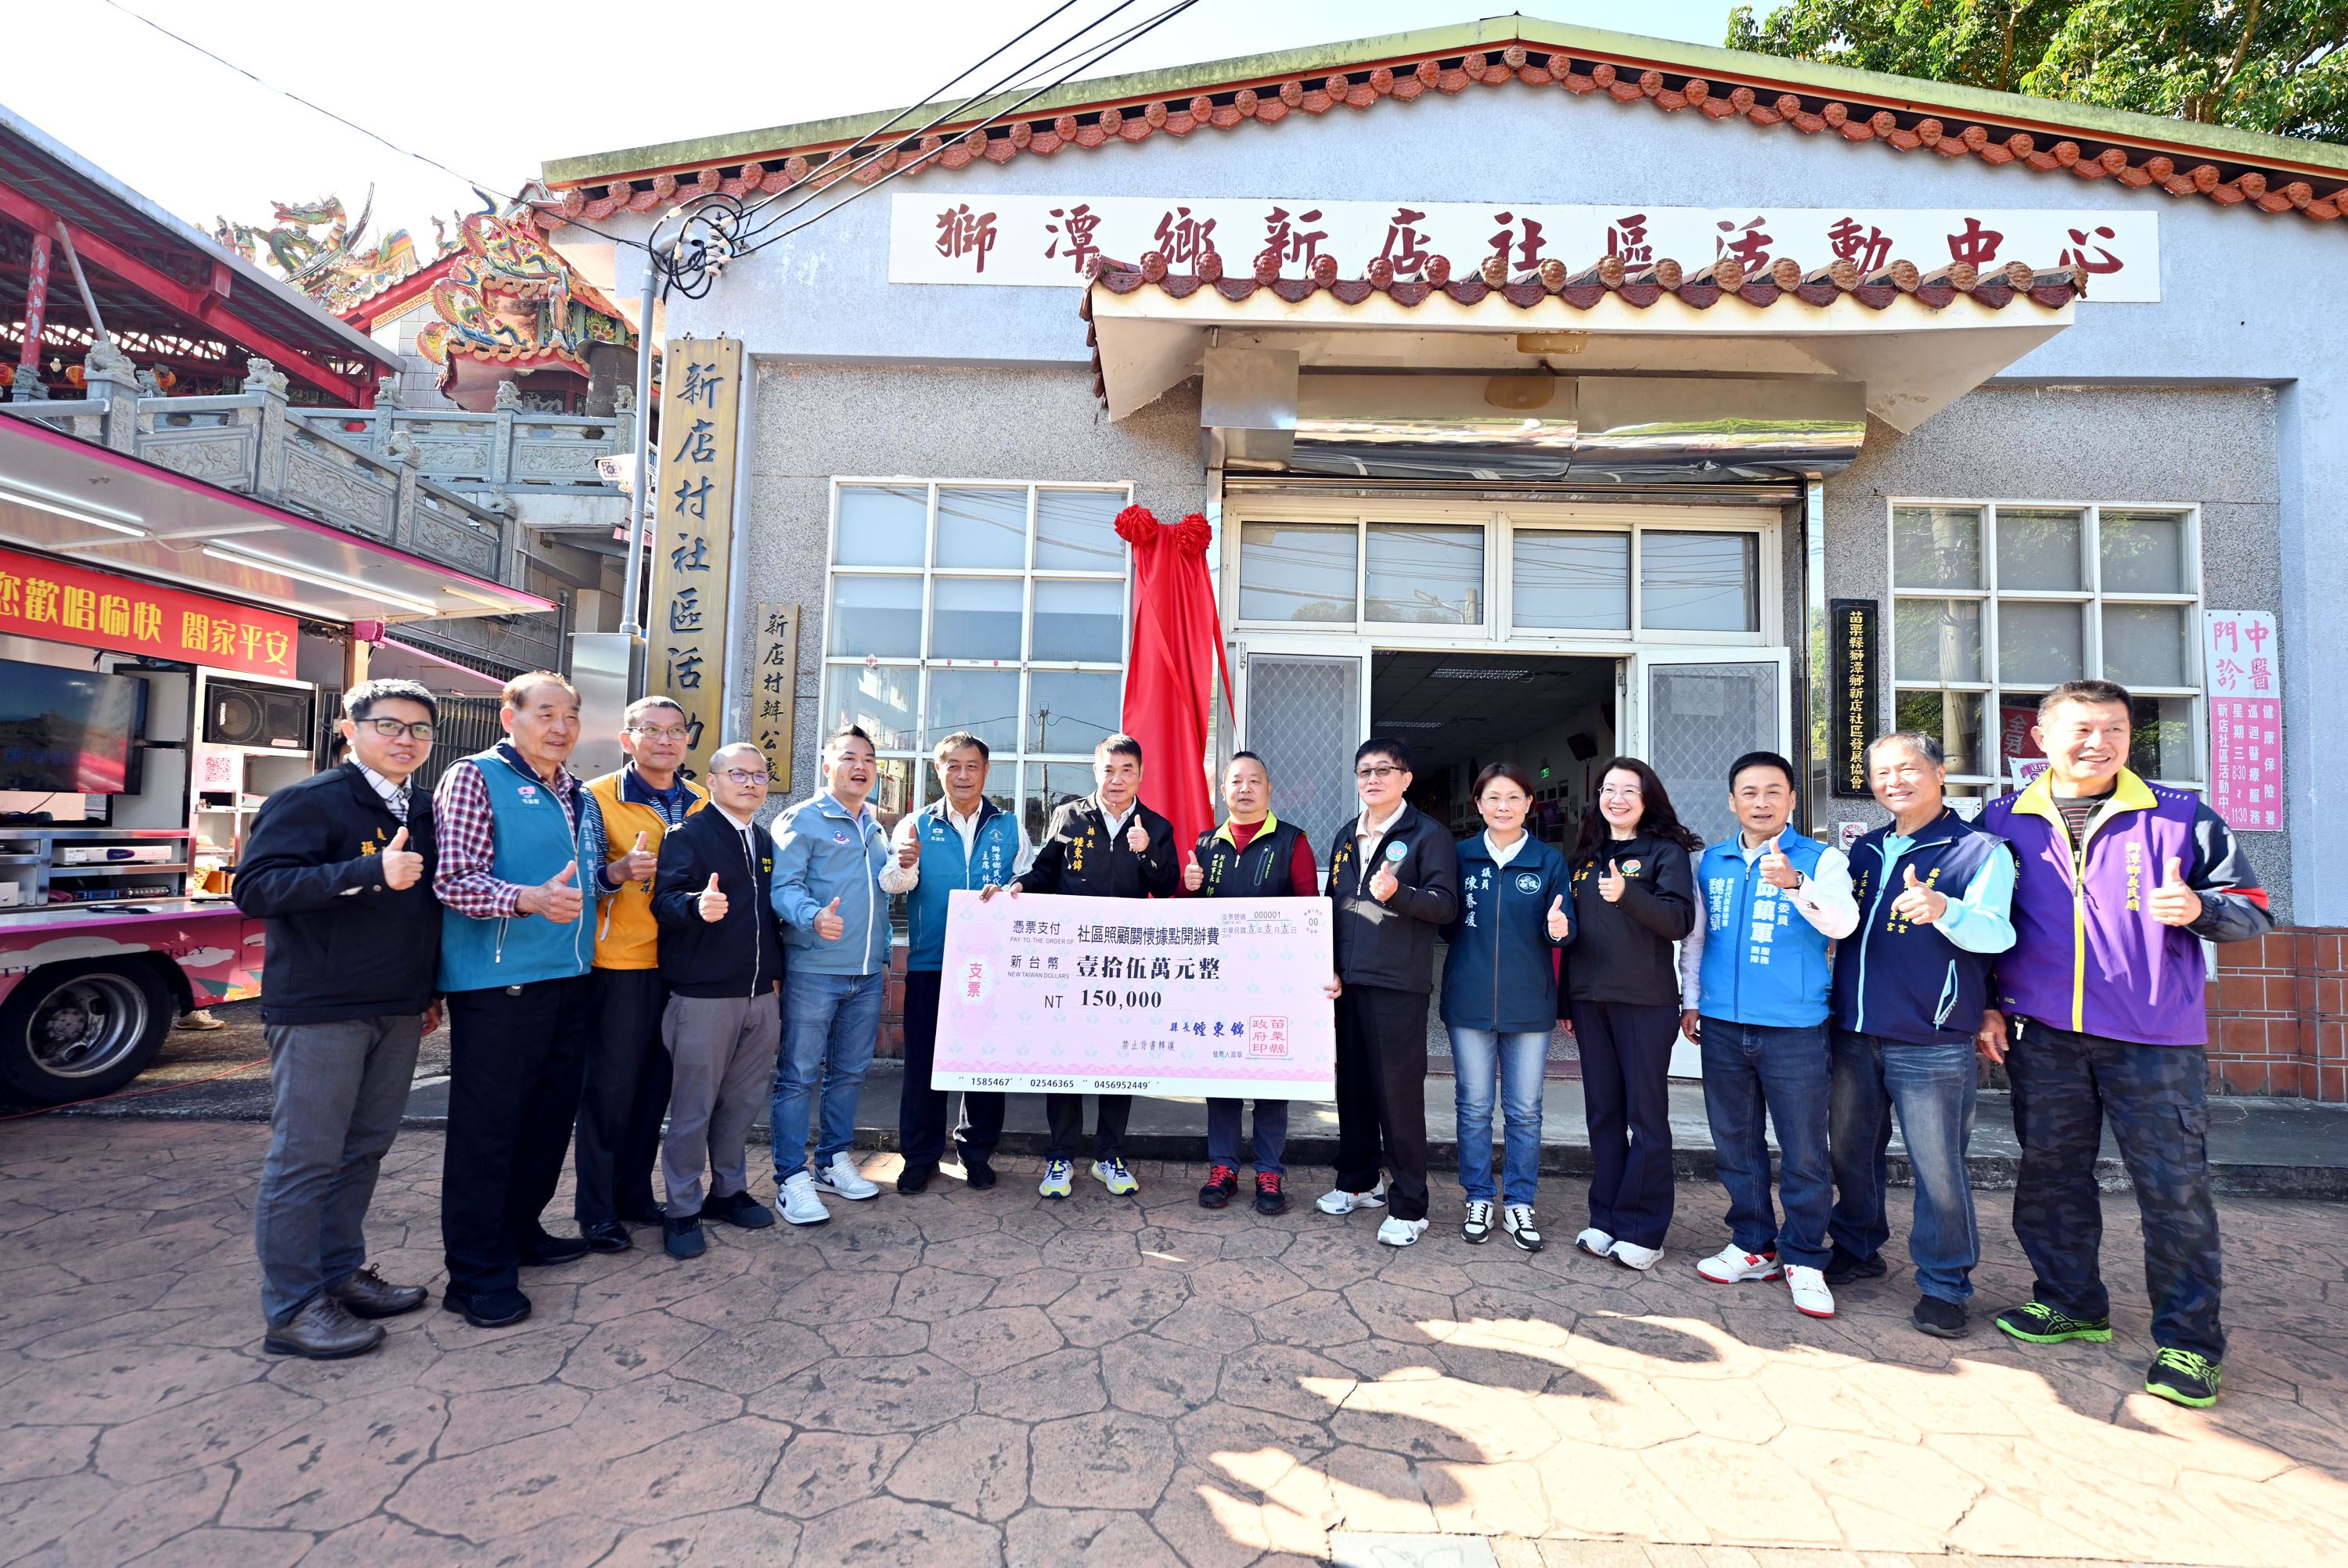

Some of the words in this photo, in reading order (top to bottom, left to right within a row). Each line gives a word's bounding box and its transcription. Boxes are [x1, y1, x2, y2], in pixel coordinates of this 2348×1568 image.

[935, 203, 2125, 276] 獅潭鄉新店社區活動中心
[0, 570, 162, 643] 您歡唱愉快
[182, 610, 289, 667] 閤家平安
[2213, 620, 2245, 692] 門診
[2245, 620, 2271, 691] 中醫
[1849, 610, 1865, 789] 苗栗縣獅潭鄉新店社區發展協會
[2217, 703, 2230, 823] 新店社區活動中心
[2248, 704, 2260, 823] 巡迴醫療服務
[2263, 704, 2275, 825] 健康保險署
[1013, 920, 1061, 935] 憑票支付
[1077, 924, 1219, 946] 社區照顧關懷據點開辦費
[1254, 911, 1280, 919] 000001
[1464, 875, 1478, 927] 陳春暖
[967, 963, 983, 998] 支票
[1010, 955, 1059, 969] 新台幣
[1076, 955, 1220, 980] 壹拾伍萬元整
[1044, 995, 1064, 1009] NT
[1081, 990, 1161, 1009] 150,000
[1030, 1079, 1074, 1088] 02546365
